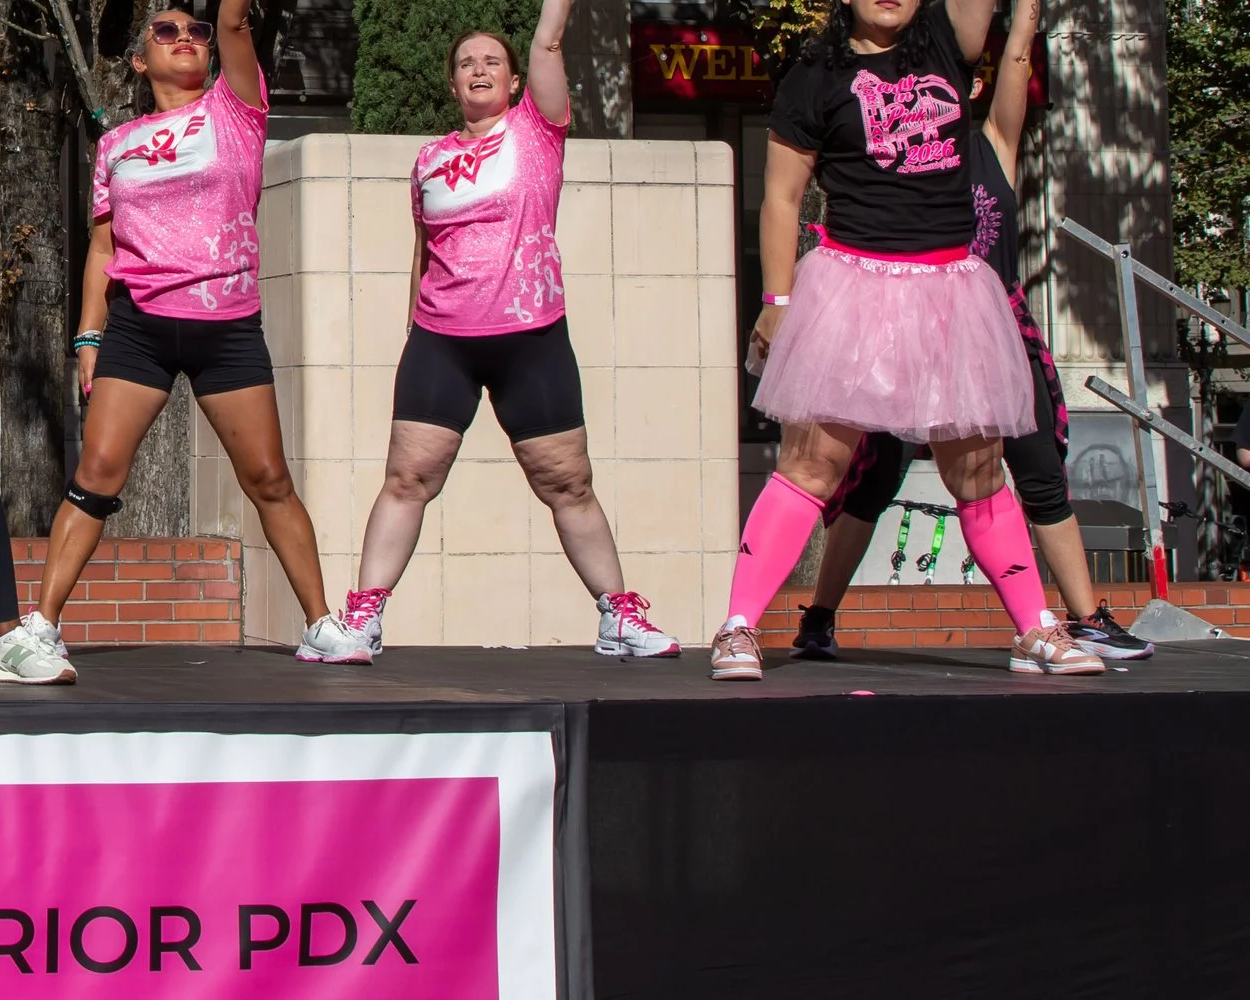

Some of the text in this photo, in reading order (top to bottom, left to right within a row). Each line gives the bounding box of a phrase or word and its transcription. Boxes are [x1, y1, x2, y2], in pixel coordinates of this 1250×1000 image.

[650, 44, 785, 81] WEL
[881, 103, 927, 128] Pink
[904, 138, 955, 165] 2026
[238, 899, 419, 970] PDX
